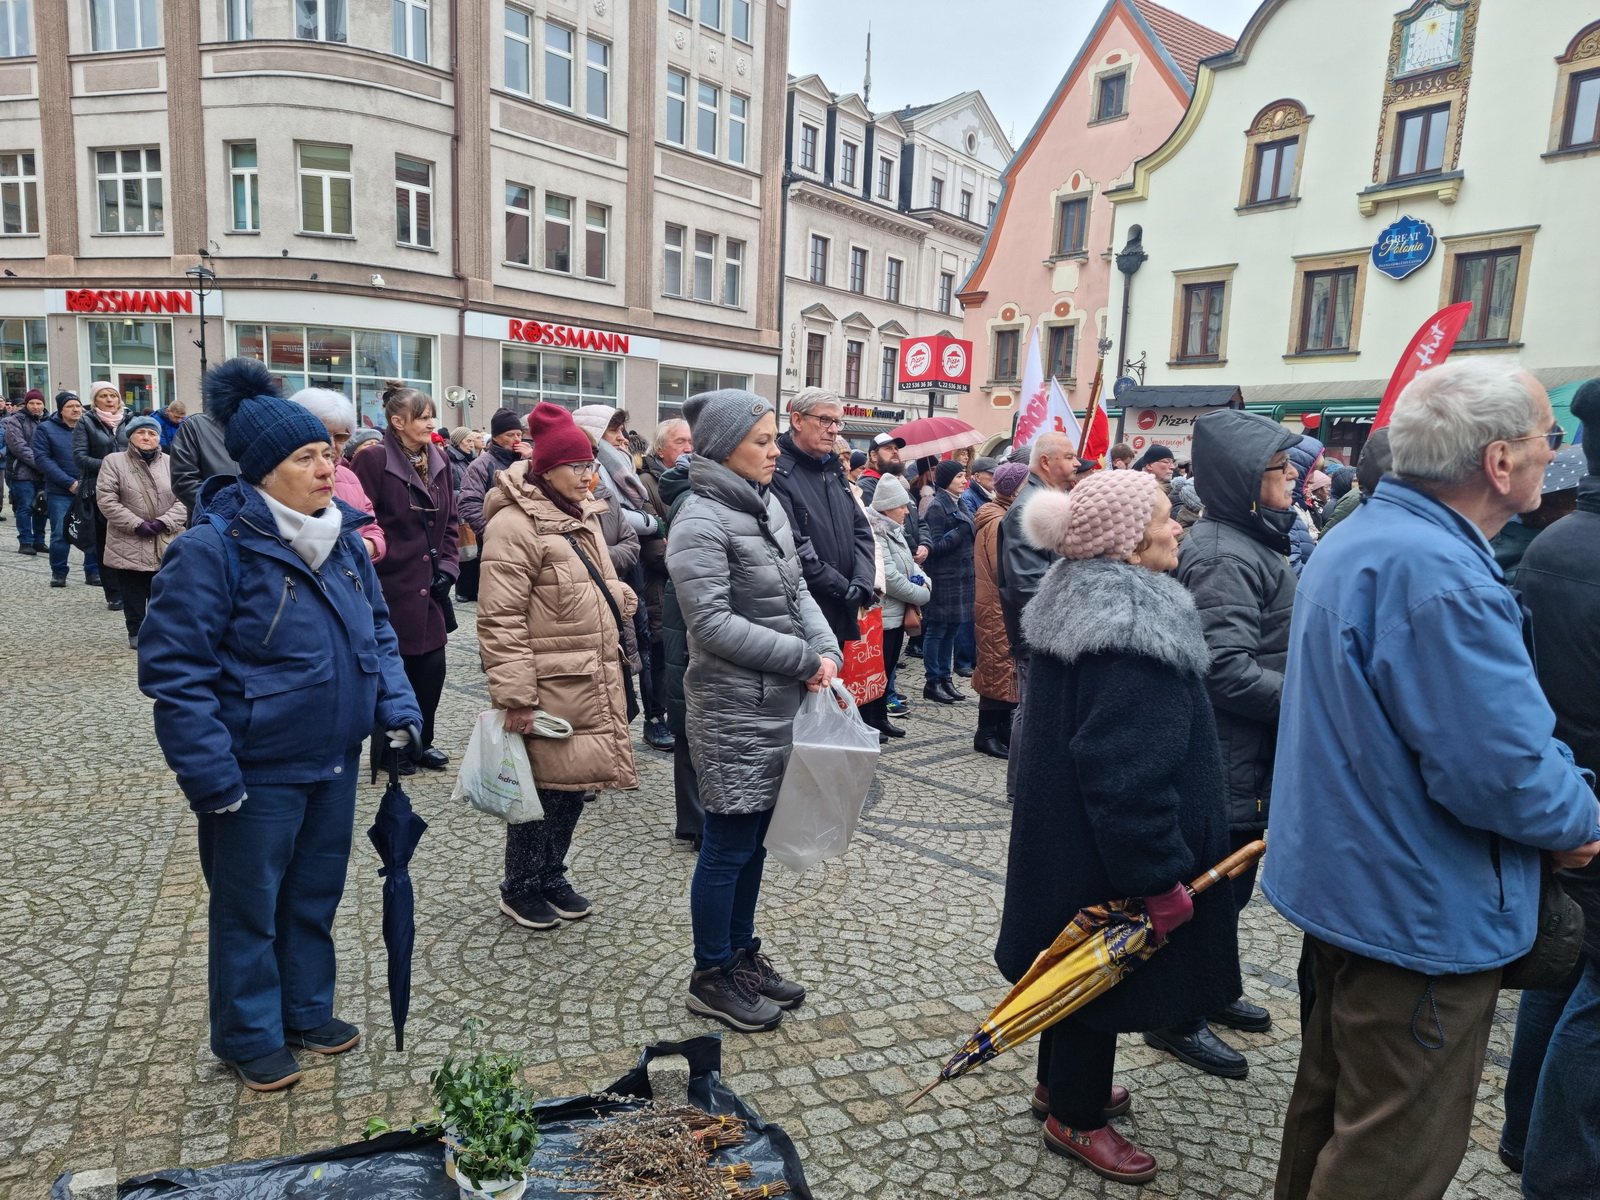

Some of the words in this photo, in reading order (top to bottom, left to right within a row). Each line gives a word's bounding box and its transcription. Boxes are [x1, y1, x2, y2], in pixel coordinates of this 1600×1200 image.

[1409, 75, 1442, 92] 1736
[1385, 231, 1421, 243] GREAT
[1379, 241, 1424, 256] Polonia
[65, 289, 192, 313] ROSSMANN
[508, 319, 629, 354] ROSSMANN
[1158, 414, 1188, 427] Pizza
